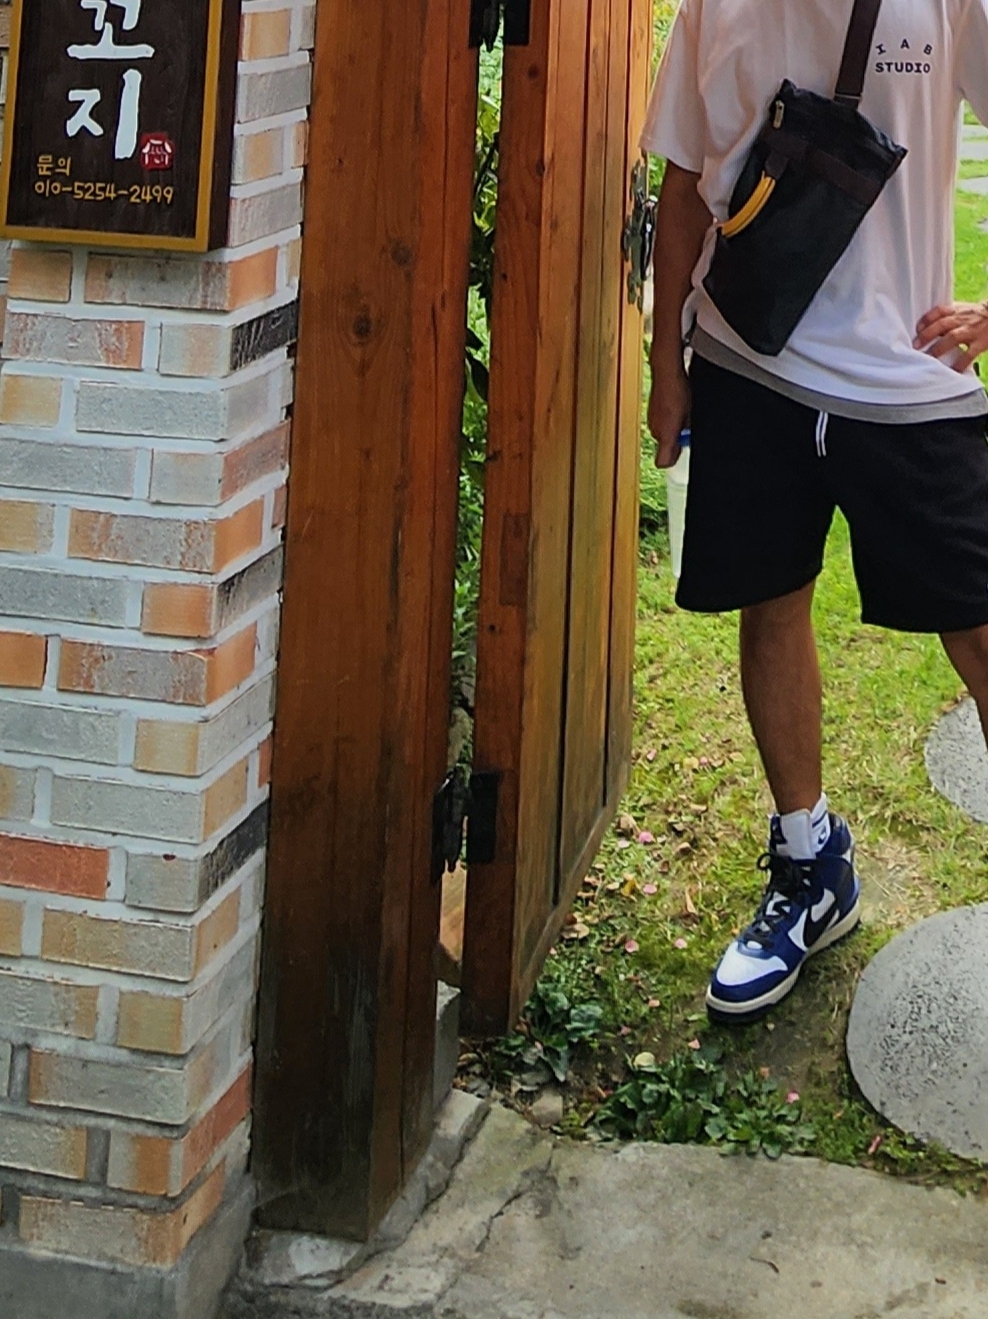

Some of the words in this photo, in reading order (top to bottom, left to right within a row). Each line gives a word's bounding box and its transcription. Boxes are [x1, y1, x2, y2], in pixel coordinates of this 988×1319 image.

[875, 38, 933, 55] IAB
[875, 62, 931, 74] STUDIO
[37, 154, 71, 176] 문의
[34, 180, 174, 204] 010-5254-2499
